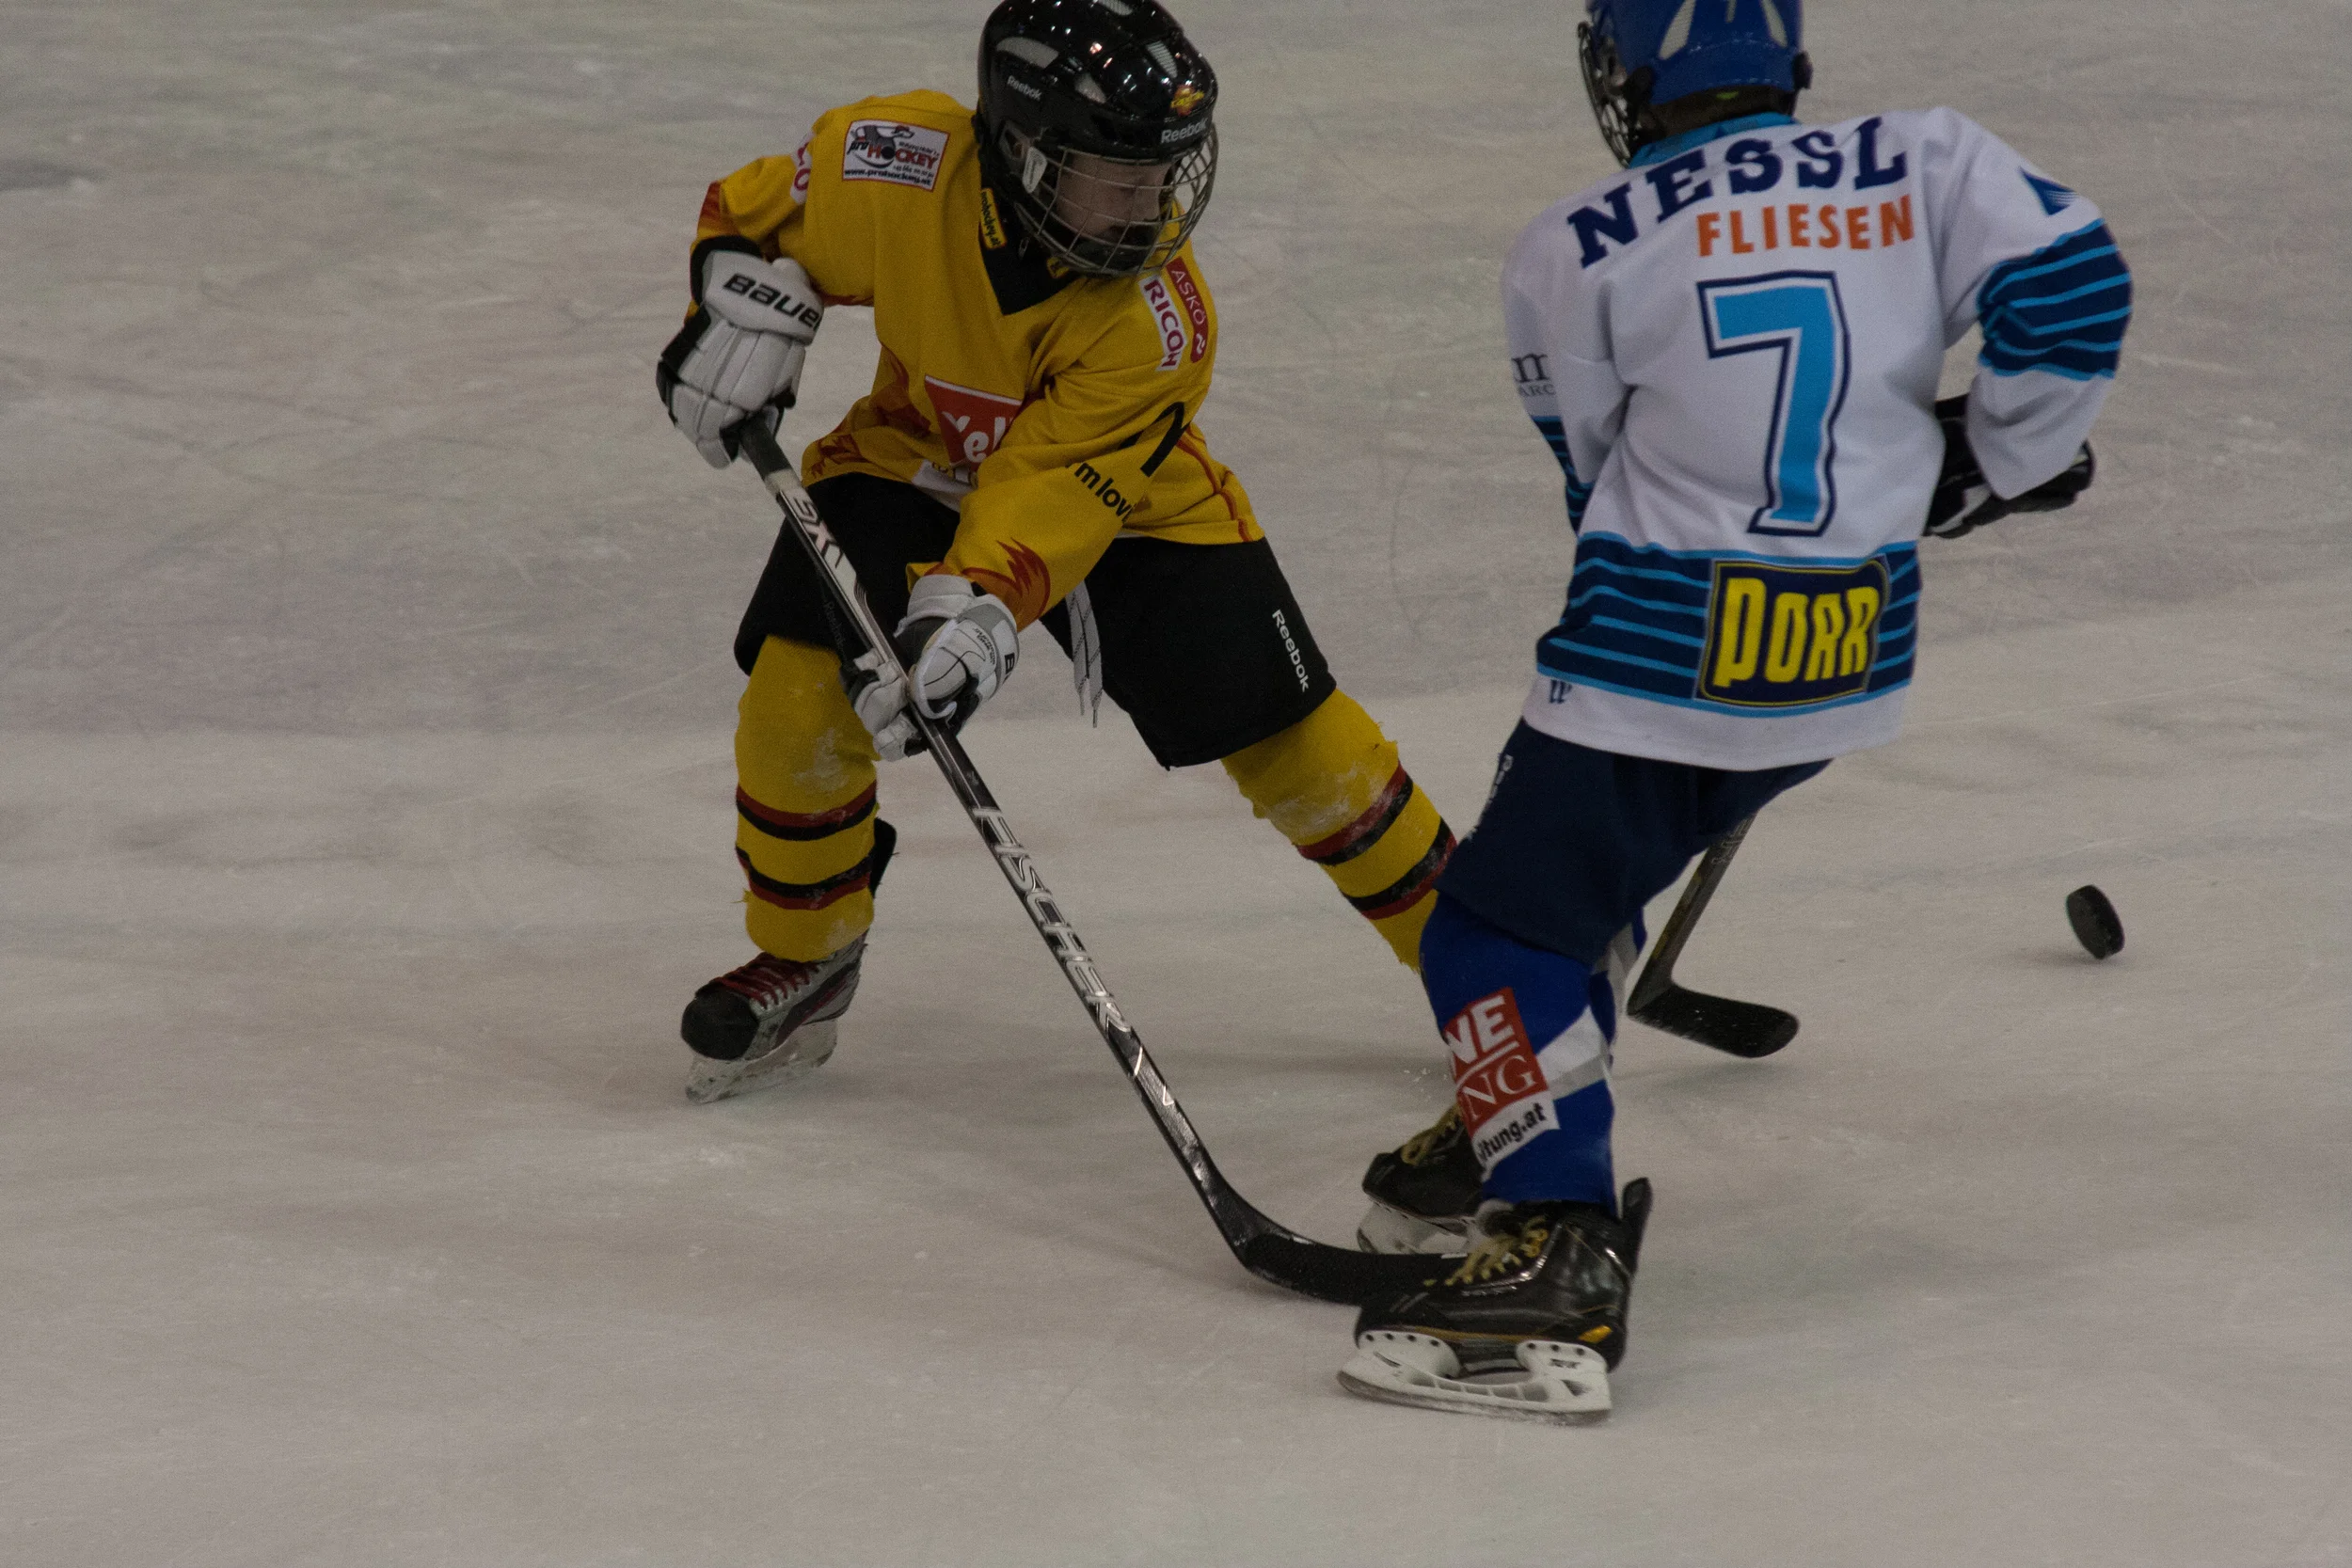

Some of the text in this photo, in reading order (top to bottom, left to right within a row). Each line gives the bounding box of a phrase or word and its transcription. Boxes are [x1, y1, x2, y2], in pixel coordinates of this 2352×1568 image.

[1007, 74, 1042, 102] Reebok
[1160, 118, 1209, 143] Reebok
[1566, 117, 1907, 268] NESSL
[1696, 195, 1914, 258] FLIESEN
[1144, 279, 1184, 368] RICOH
[1696, 270, 1851, 537] 7
[1272, 609, 1310, 693] Reebok
[1712, 577, 1880, 689] PORR
[972, 806, 1131, 1036] FISCHER
